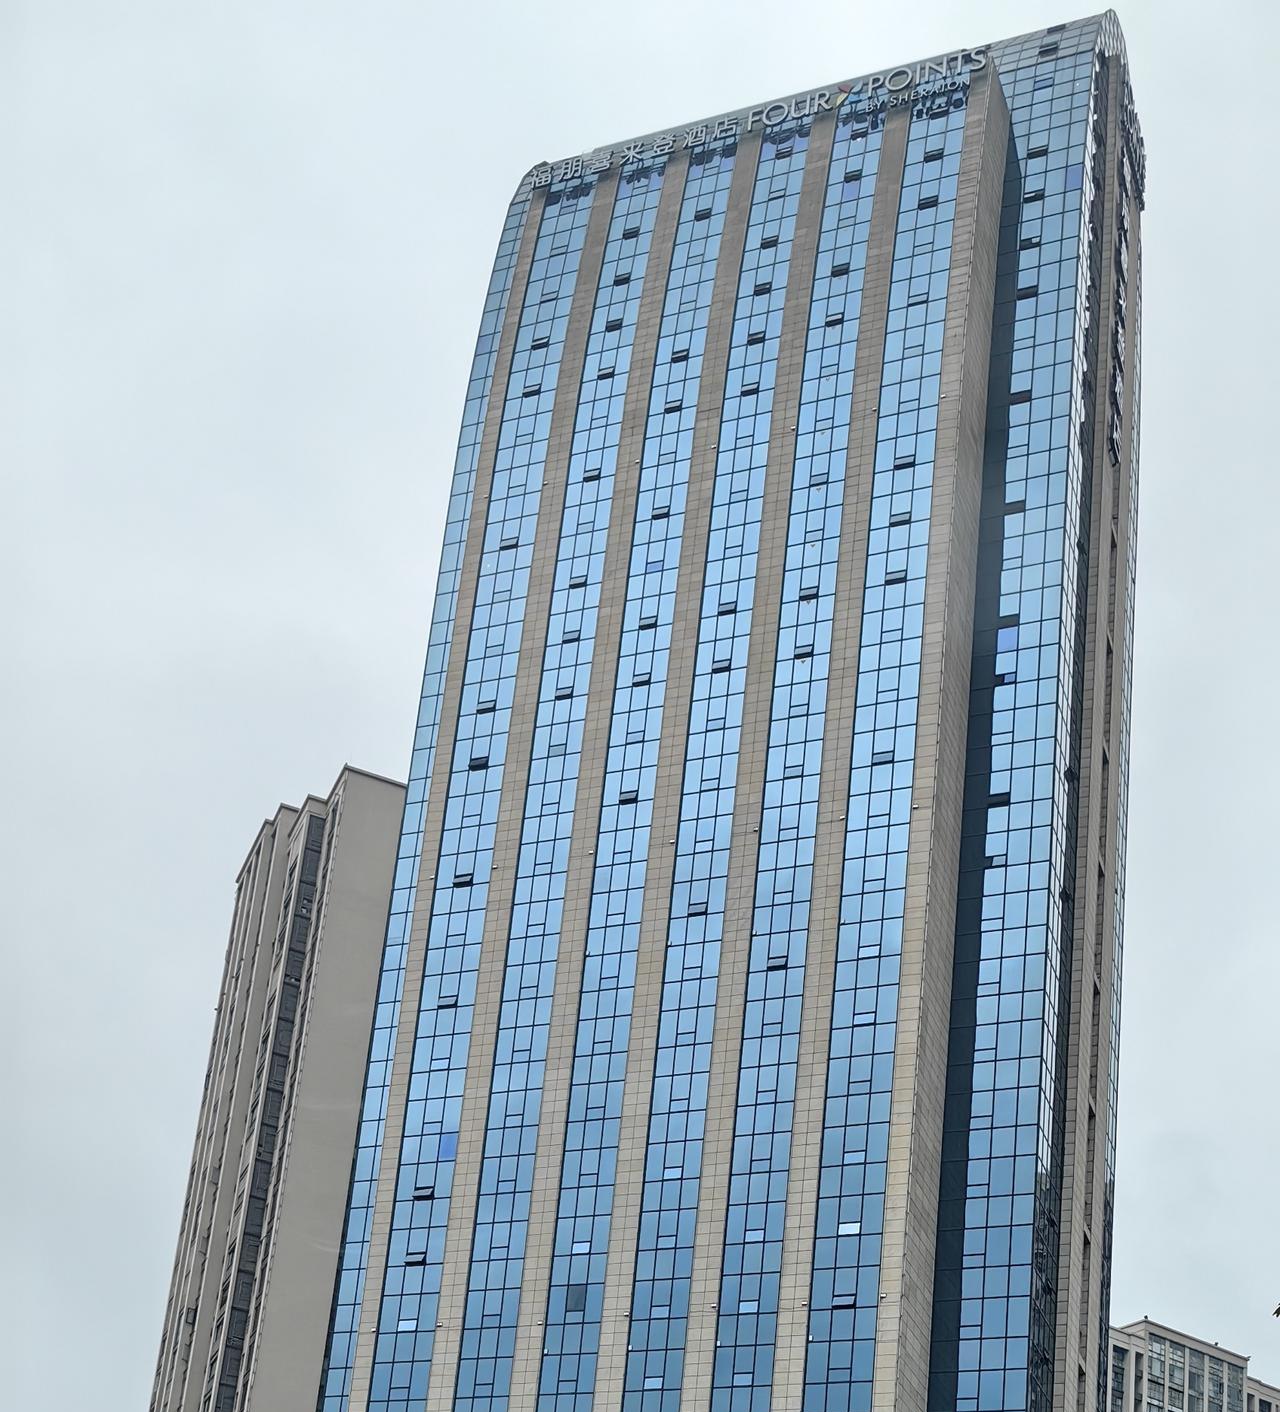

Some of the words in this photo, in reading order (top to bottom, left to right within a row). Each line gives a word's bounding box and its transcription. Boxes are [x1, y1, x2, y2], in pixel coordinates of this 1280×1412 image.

[747, 90, 833, 131] FOUR
[867, 49, 987, 97] POINTS
[865, 99, 883, 113] BY
[889, 77, 971, 107] SHERATON
[530, 116, 738, 188] 福朋喜来登酒店
